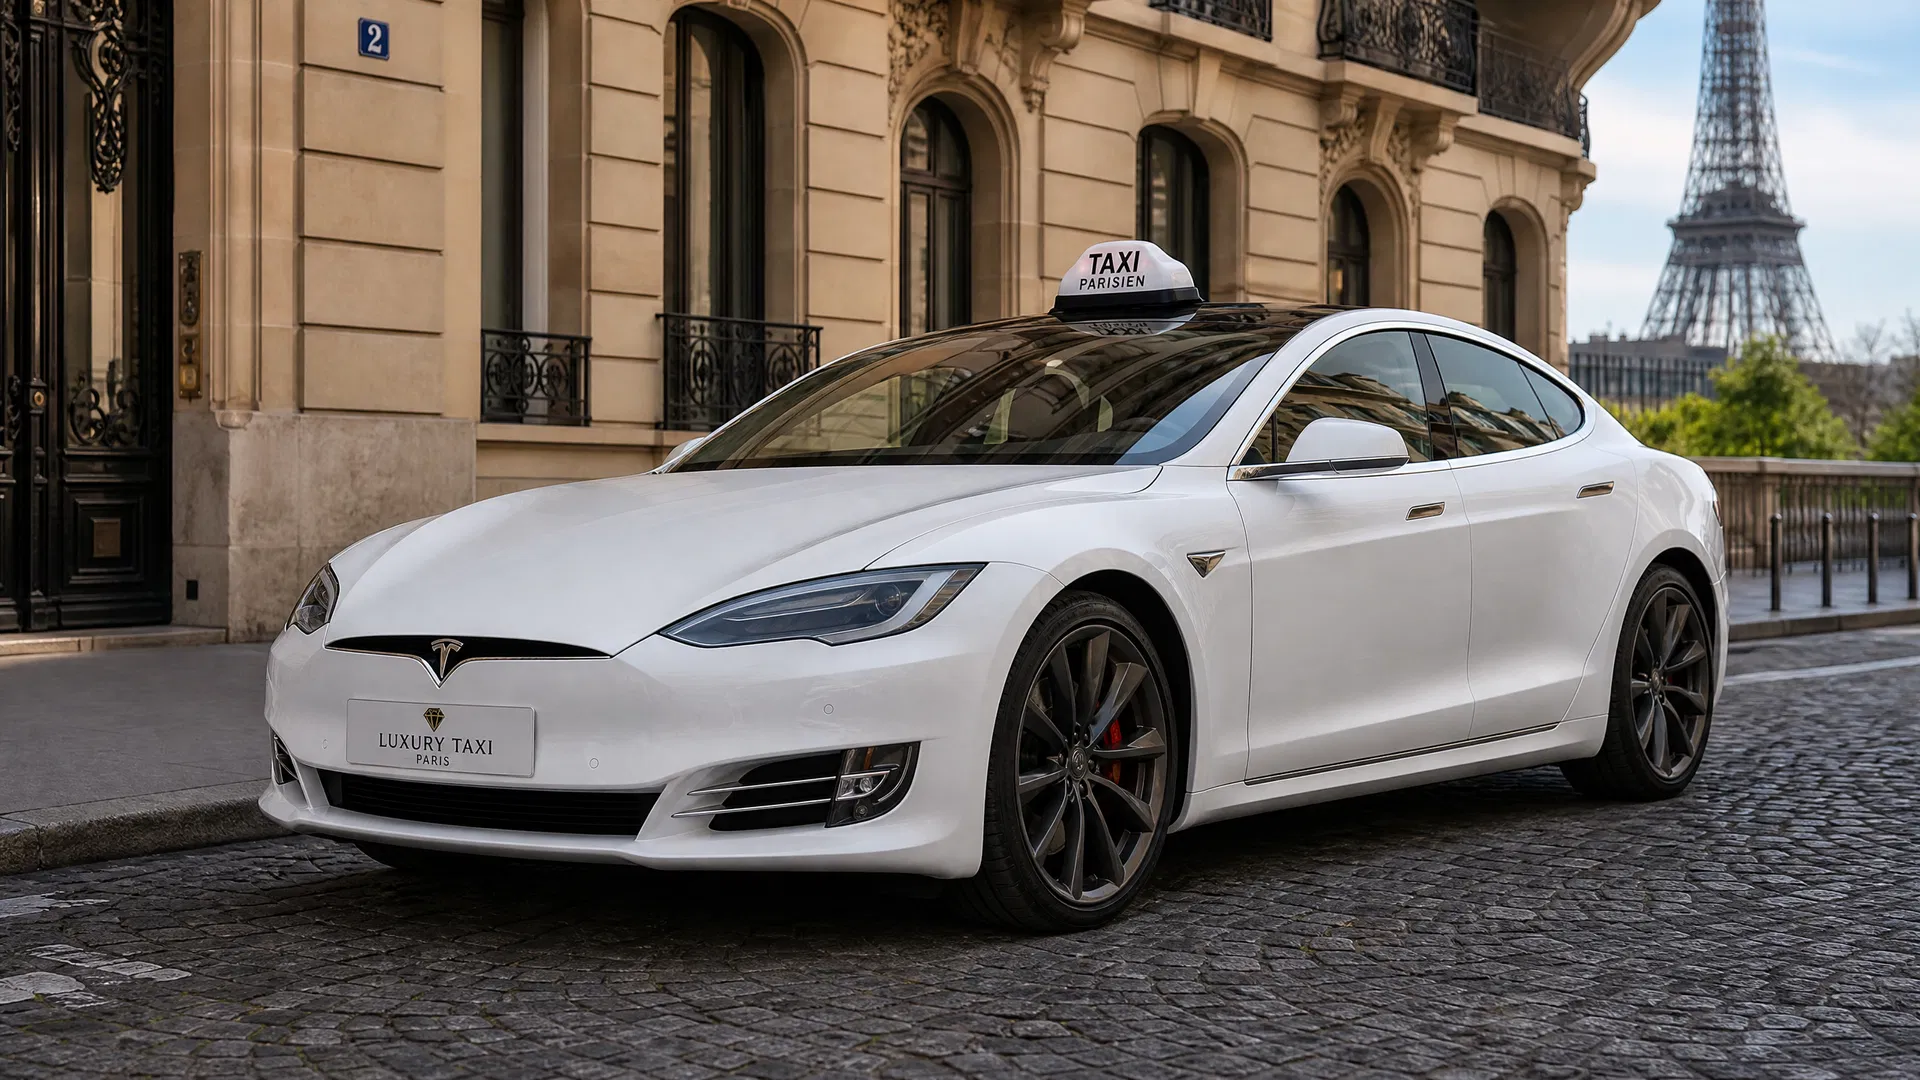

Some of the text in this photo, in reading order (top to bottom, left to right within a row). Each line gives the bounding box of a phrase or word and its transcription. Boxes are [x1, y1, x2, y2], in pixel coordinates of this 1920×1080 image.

[367, 23, 382, 54] 2
[1089, 251, 1140, 275] TAXI
[1079, 275, 1145, 290] PARISIEN
[379, 732, 493, 755] LUXURY TAXI
[416, 754, 450, 767] PARIS
